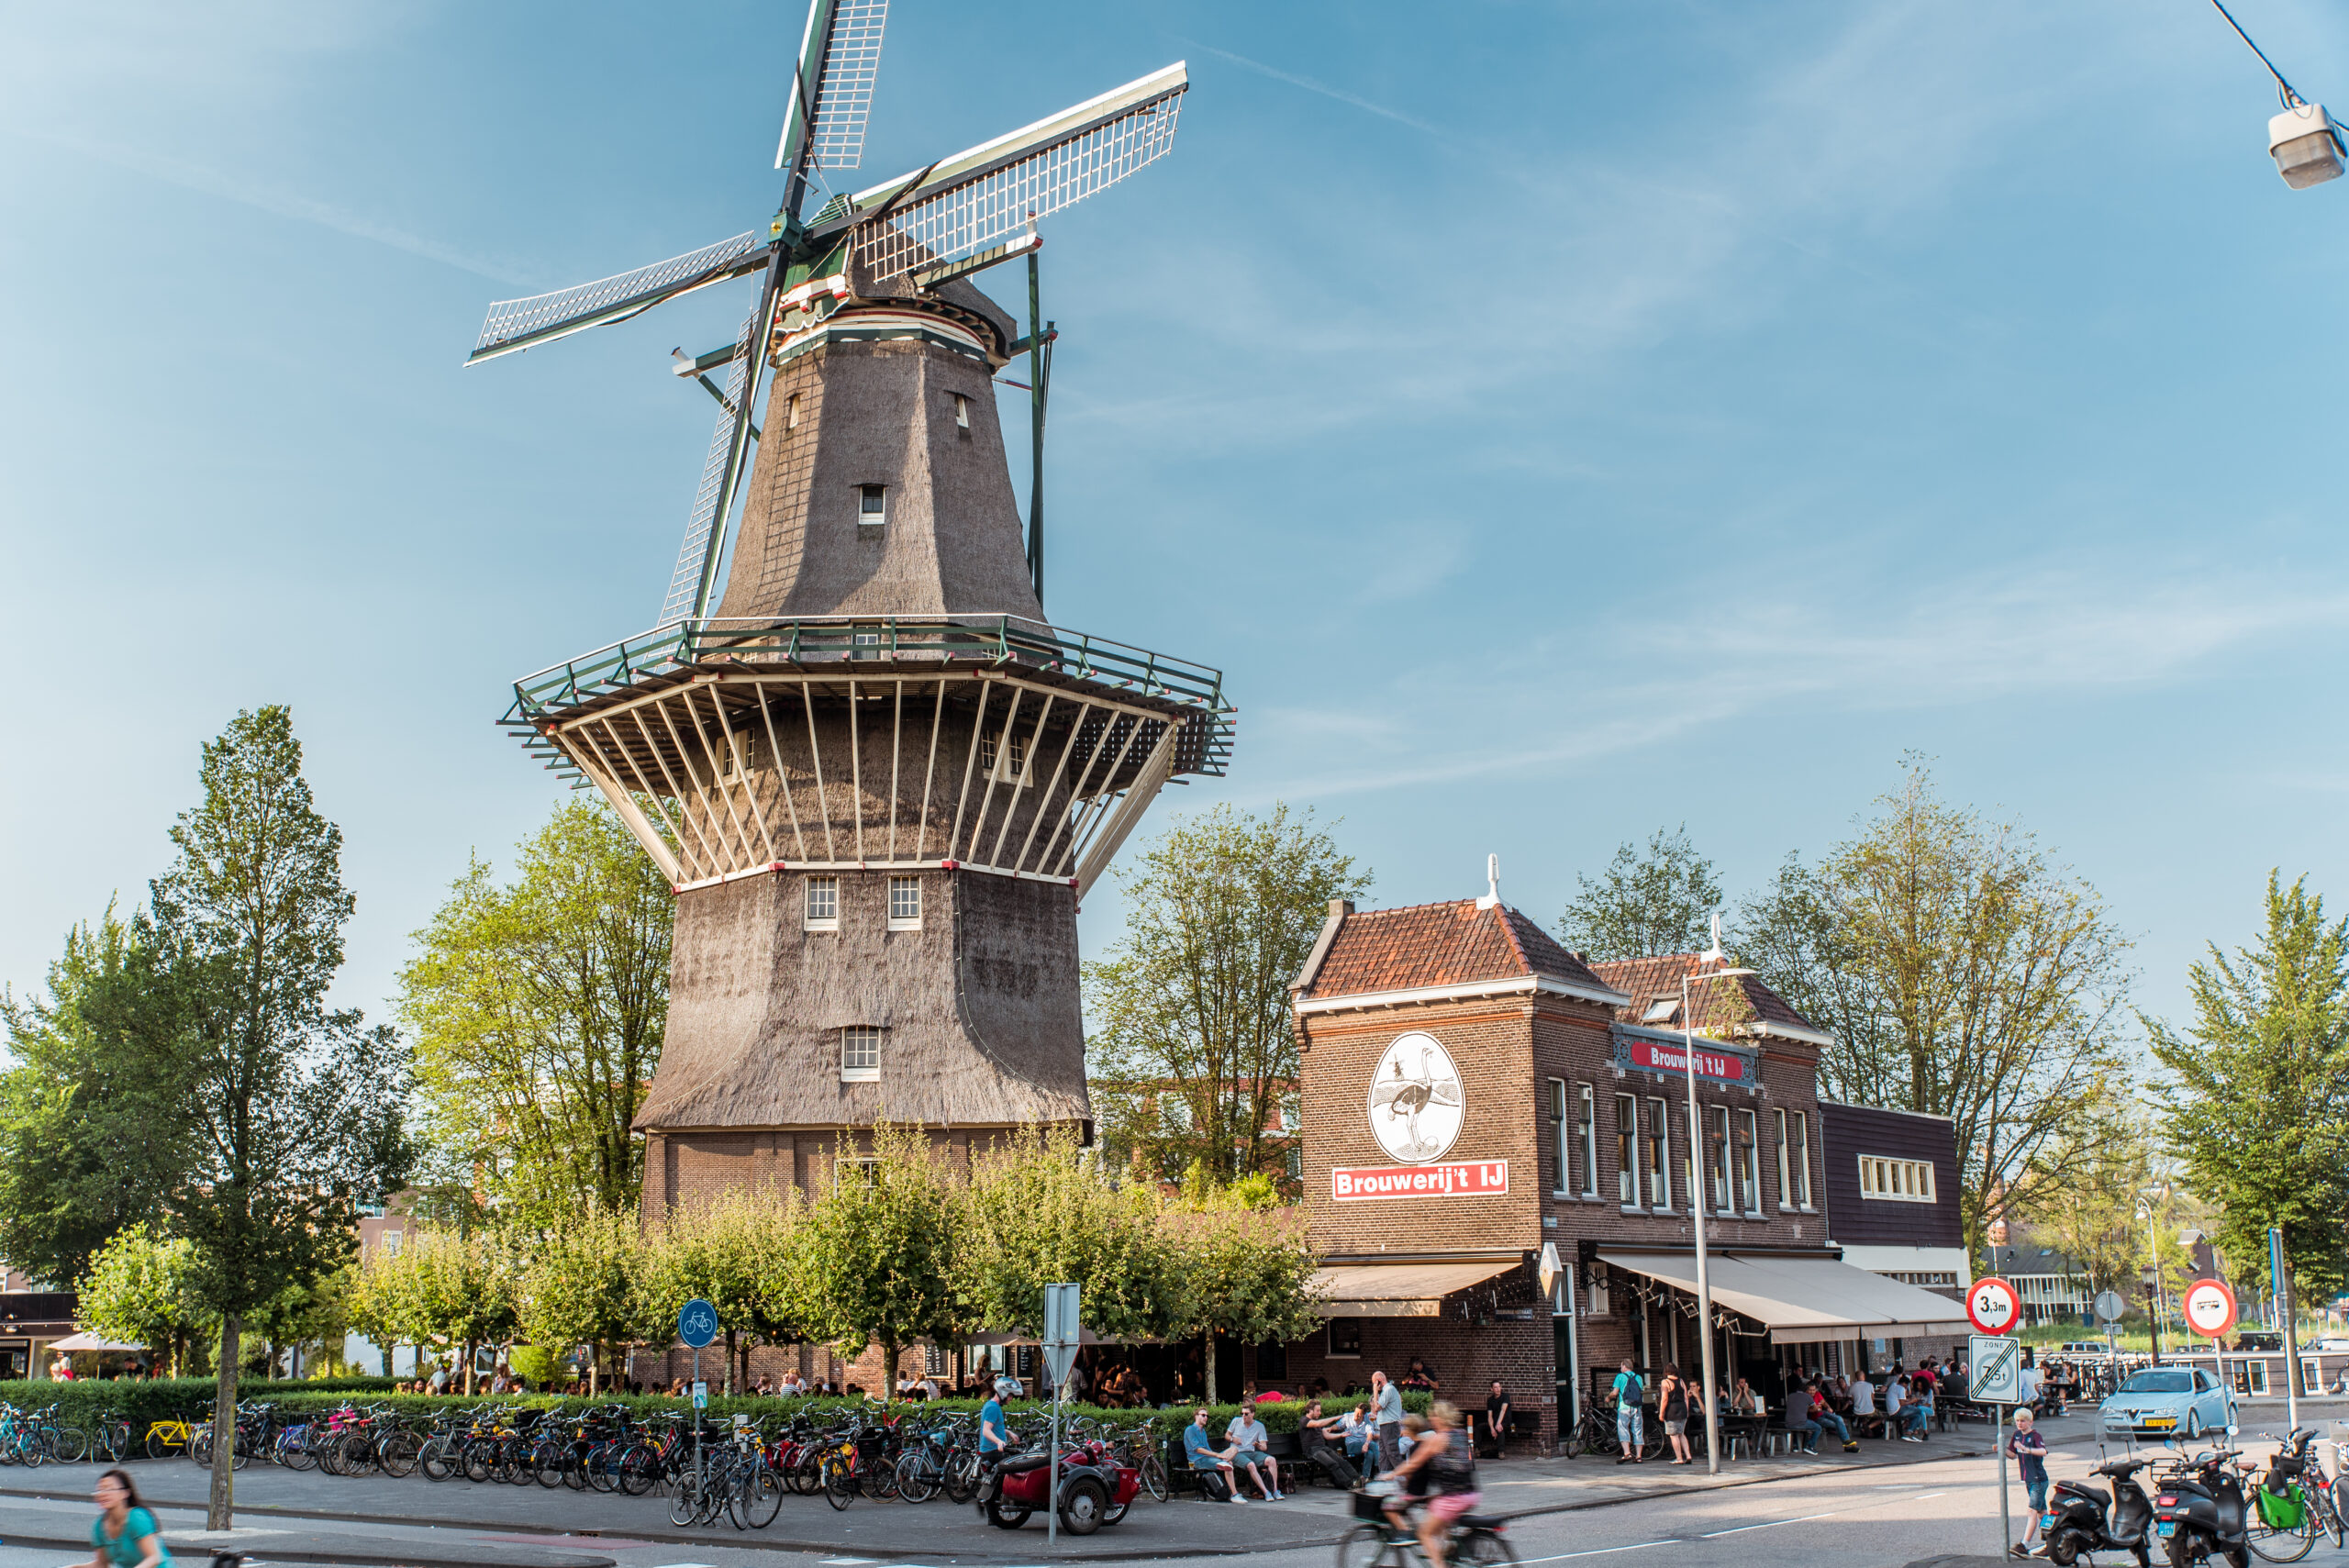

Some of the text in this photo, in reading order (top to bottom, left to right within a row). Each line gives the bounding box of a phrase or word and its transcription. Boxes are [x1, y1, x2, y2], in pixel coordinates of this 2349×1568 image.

[1651, 1047, 1704, 1075] Brouwrij
[1714, 1058, 1725, 1076] IJ
[1480, 1163, 1505, 1187] IJ
